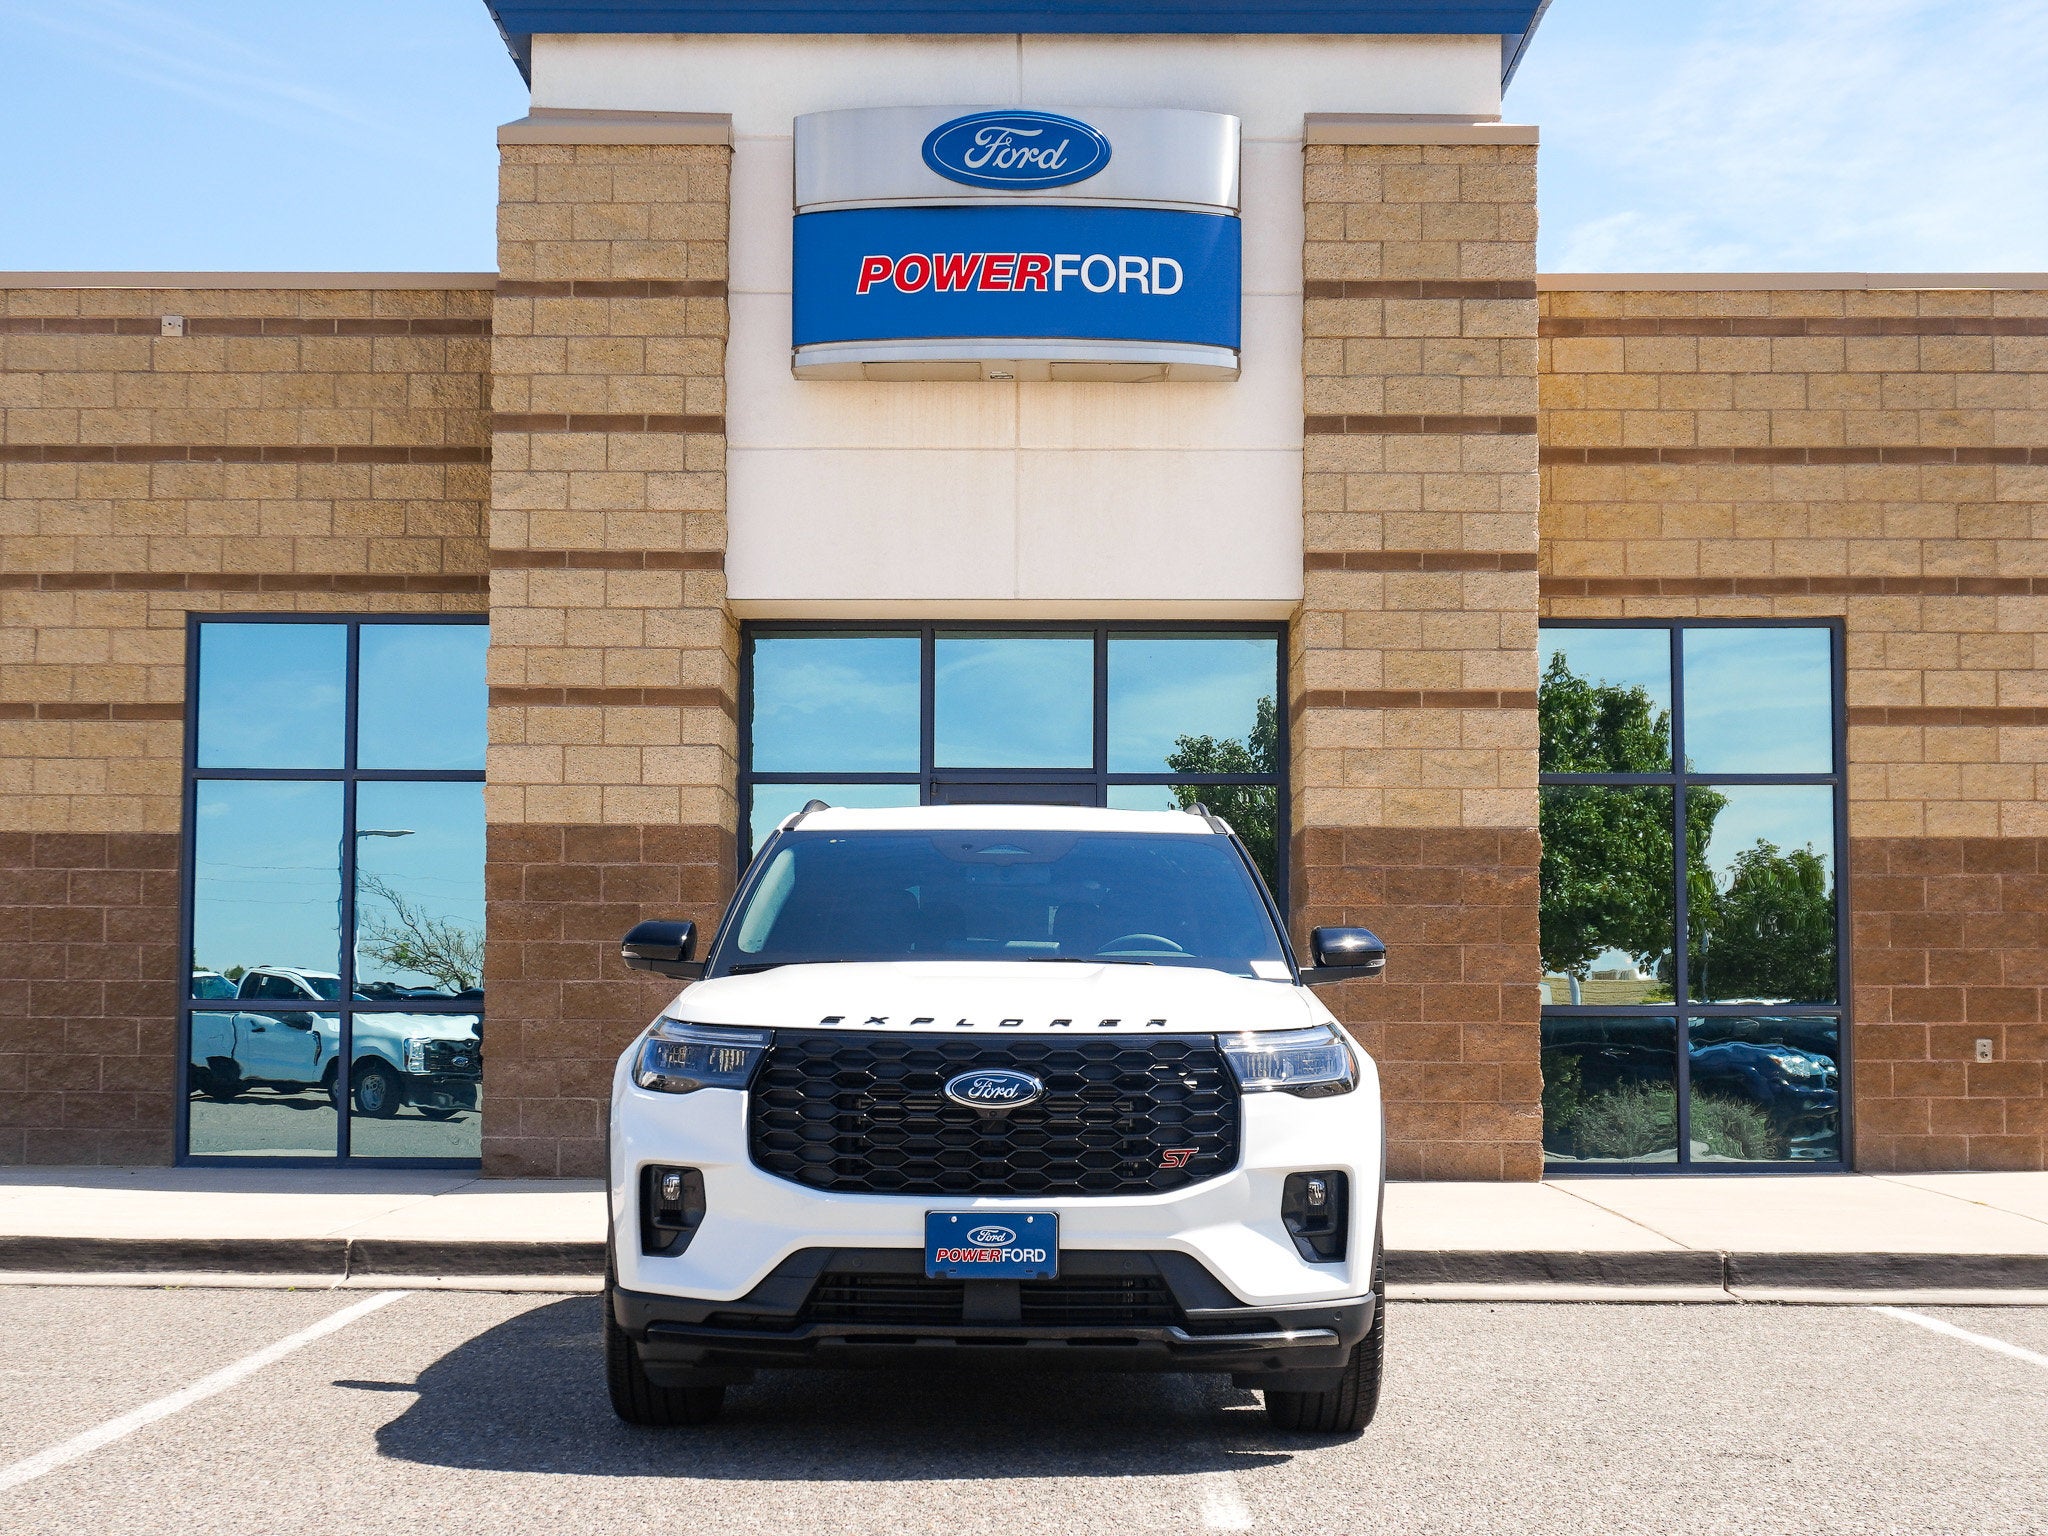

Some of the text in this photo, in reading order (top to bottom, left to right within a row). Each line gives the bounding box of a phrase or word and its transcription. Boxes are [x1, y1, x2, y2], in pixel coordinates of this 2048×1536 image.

[964, 126, 1069, 172] Ford
[819, 1015, 1168, 1027] EXPLORER
[968, 1077, 1020, 1099] Ford
[1159, 1147, 1200, 1169] ST
[976, 1229, 1006, 1242] Ford
